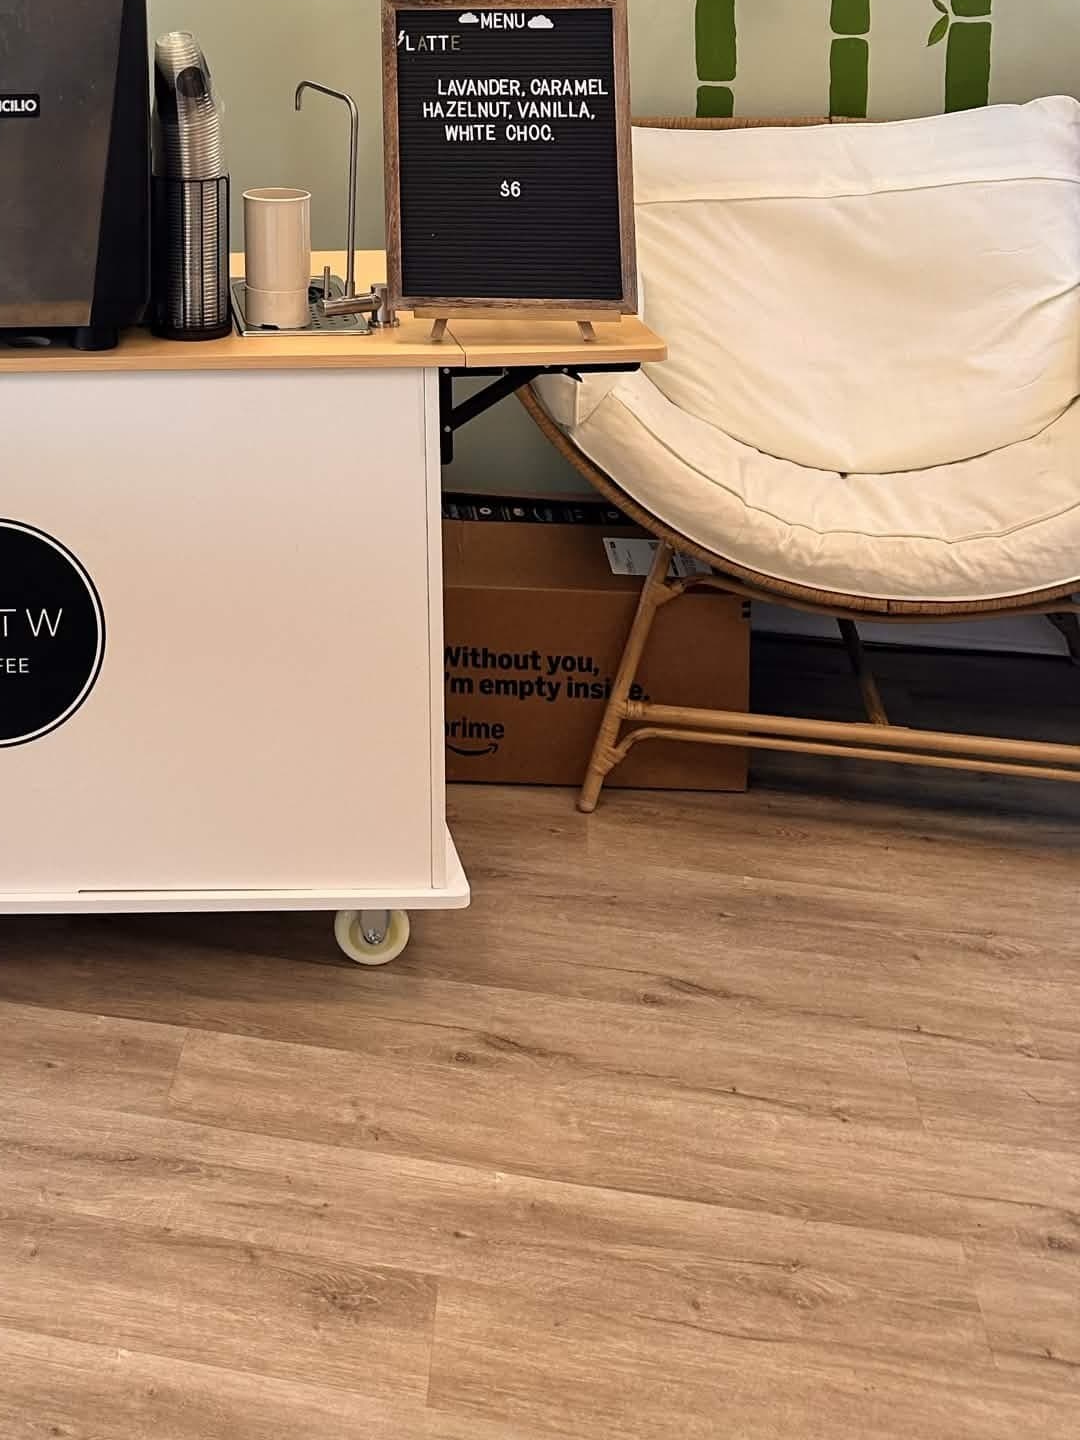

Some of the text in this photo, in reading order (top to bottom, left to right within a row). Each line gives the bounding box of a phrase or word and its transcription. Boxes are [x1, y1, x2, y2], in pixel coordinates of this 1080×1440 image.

[481, 12, 525, 29] MENU
[405, 35, 460, 51] LATTE
[438, 79, 608, 97] LAVANDER, CARAMEL
[423, 101, 596, 120] HAZELNUT, VANILLA,
[445, 124, 555, 141] WHITE CHOC.
[500, 181, 520, 197] $6
[445, 646, 600, 676] Without you,
[445, 672, 650, 702] 'm empty insie.
